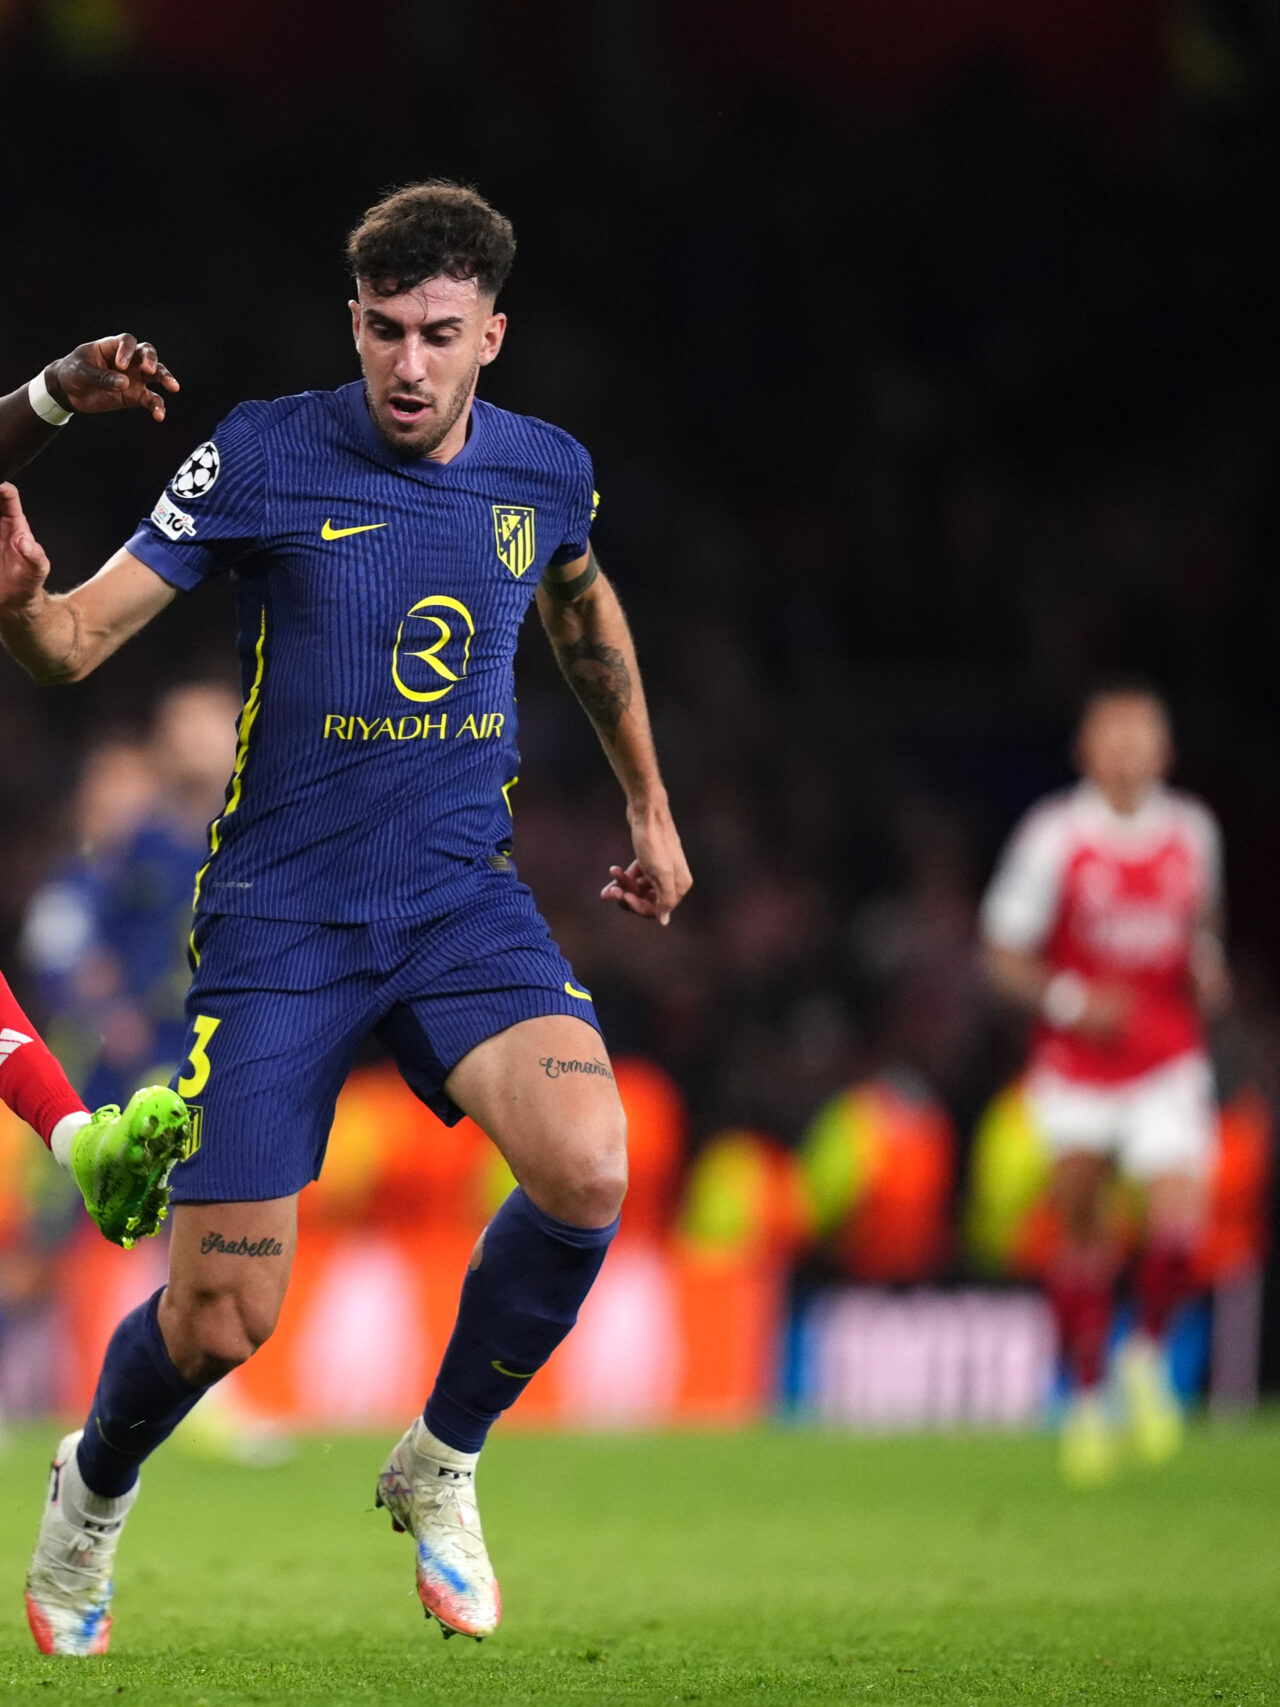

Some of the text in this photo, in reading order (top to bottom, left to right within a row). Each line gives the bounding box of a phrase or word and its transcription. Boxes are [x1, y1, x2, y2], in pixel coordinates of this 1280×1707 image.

[324, 713, 506, 741] RIYADH AIR
[177, 1015, 222, 1098] 3
[200, 1230, 283, 1258] Isabella
